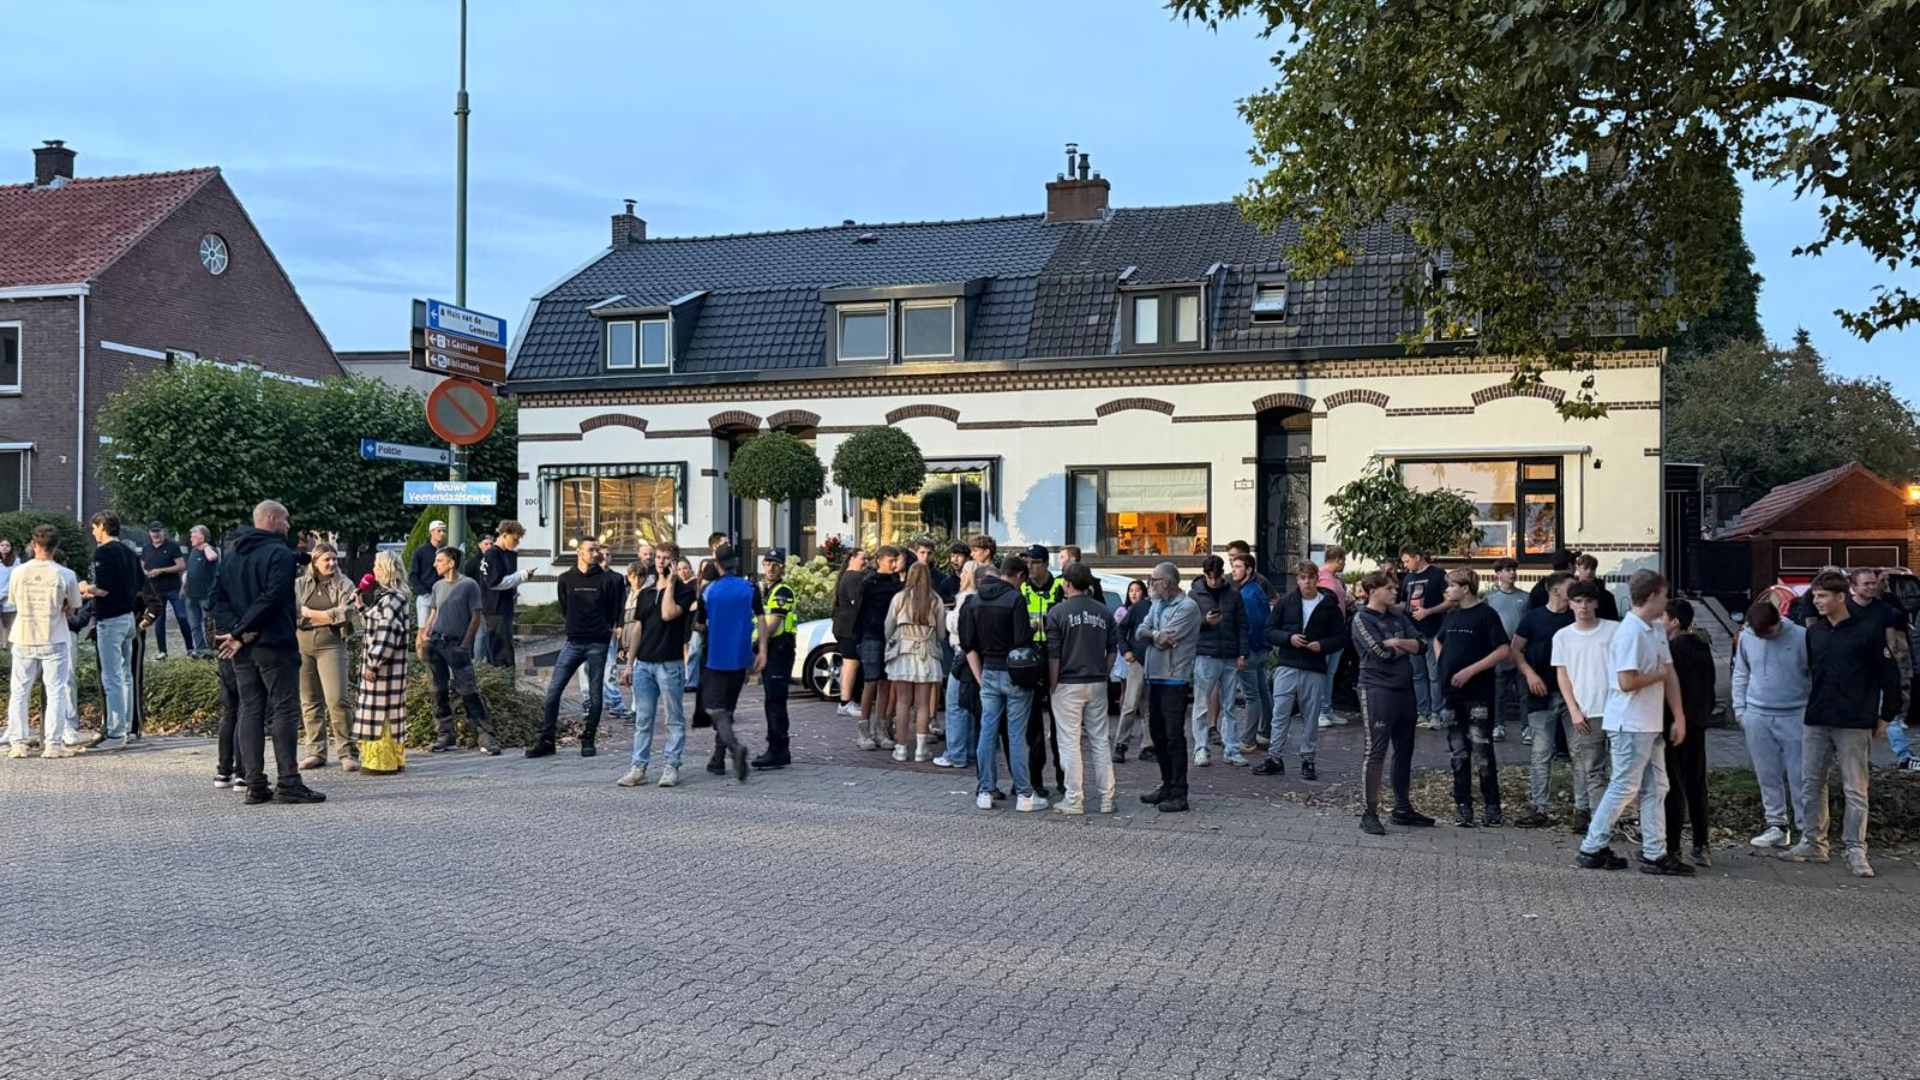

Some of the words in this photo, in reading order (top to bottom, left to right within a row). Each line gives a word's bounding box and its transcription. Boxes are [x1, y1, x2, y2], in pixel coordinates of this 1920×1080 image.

[447, 308, 460, 319] Huis
[462, 313, 473, 322] van
[474, 316, 481, 325] de
[468, 324, 498, 339] Gemeente
[447, 357, 480, 373] Bibliotheek
[378, 445, 402, 456] Politie
[433, 482, 467, 492] Nieuwe
[408, 492, 492, 505] Veenendaalseweg
[1068, 613, 1081, 628] Los
[1082, 610, 1106, 630] Angeles
